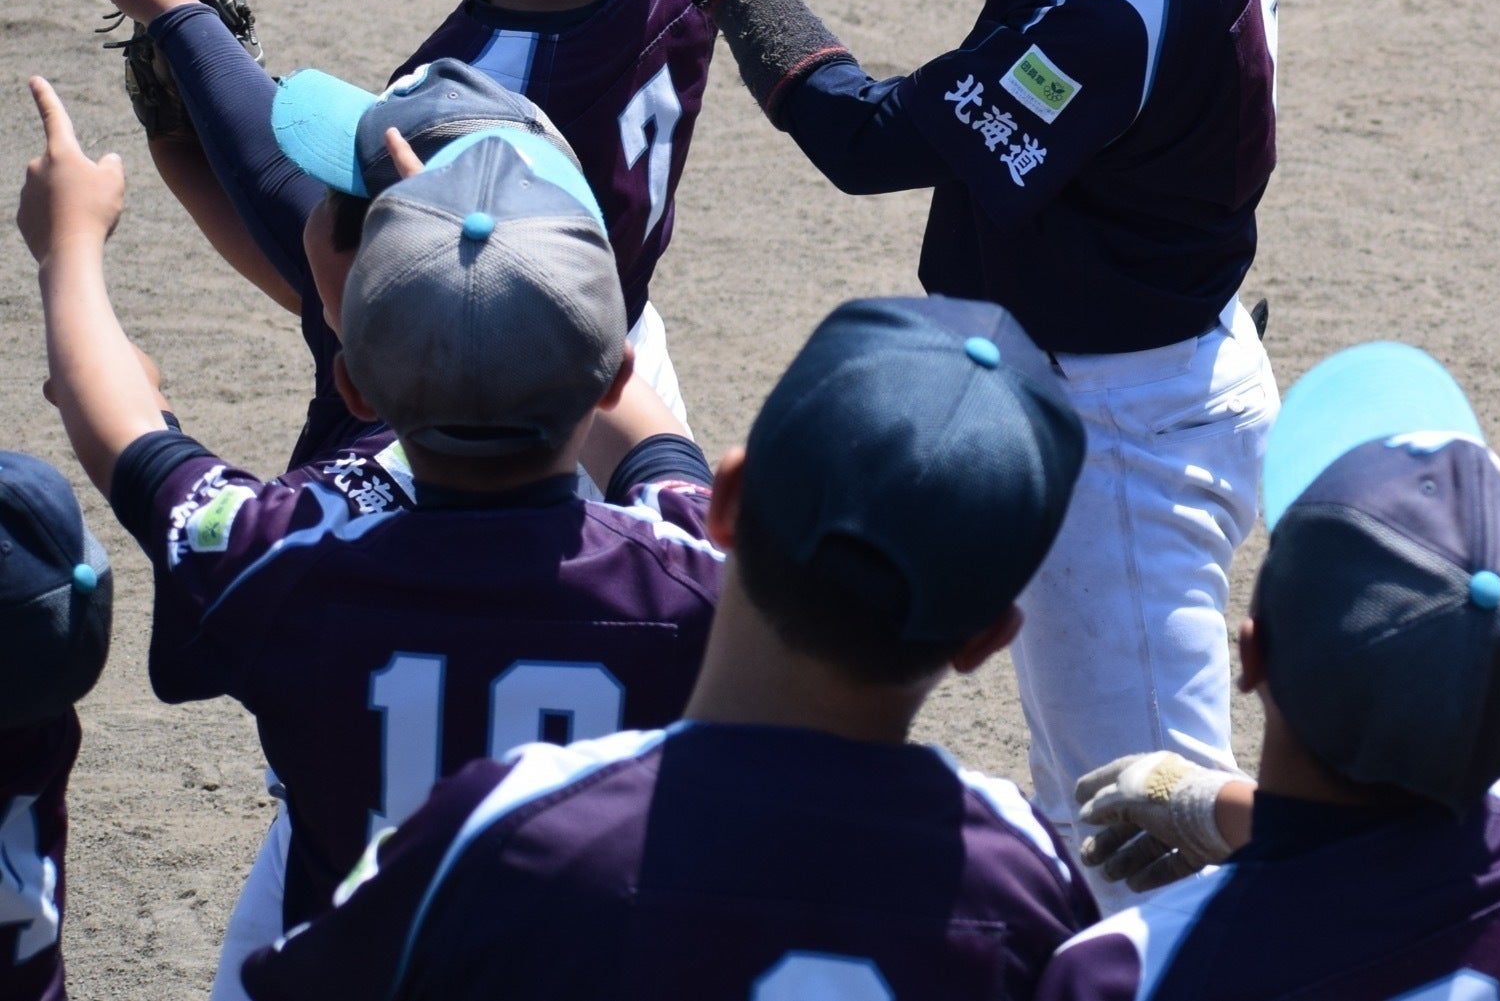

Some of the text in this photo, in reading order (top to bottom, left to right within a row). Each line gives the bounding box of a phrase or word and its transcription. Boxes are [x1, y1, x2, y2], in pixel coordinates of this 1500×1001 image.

[617, 62, 683, 246] 7
[944, 73, 1047, 187] 北海道
[324, 453, 394, 515] 北海
